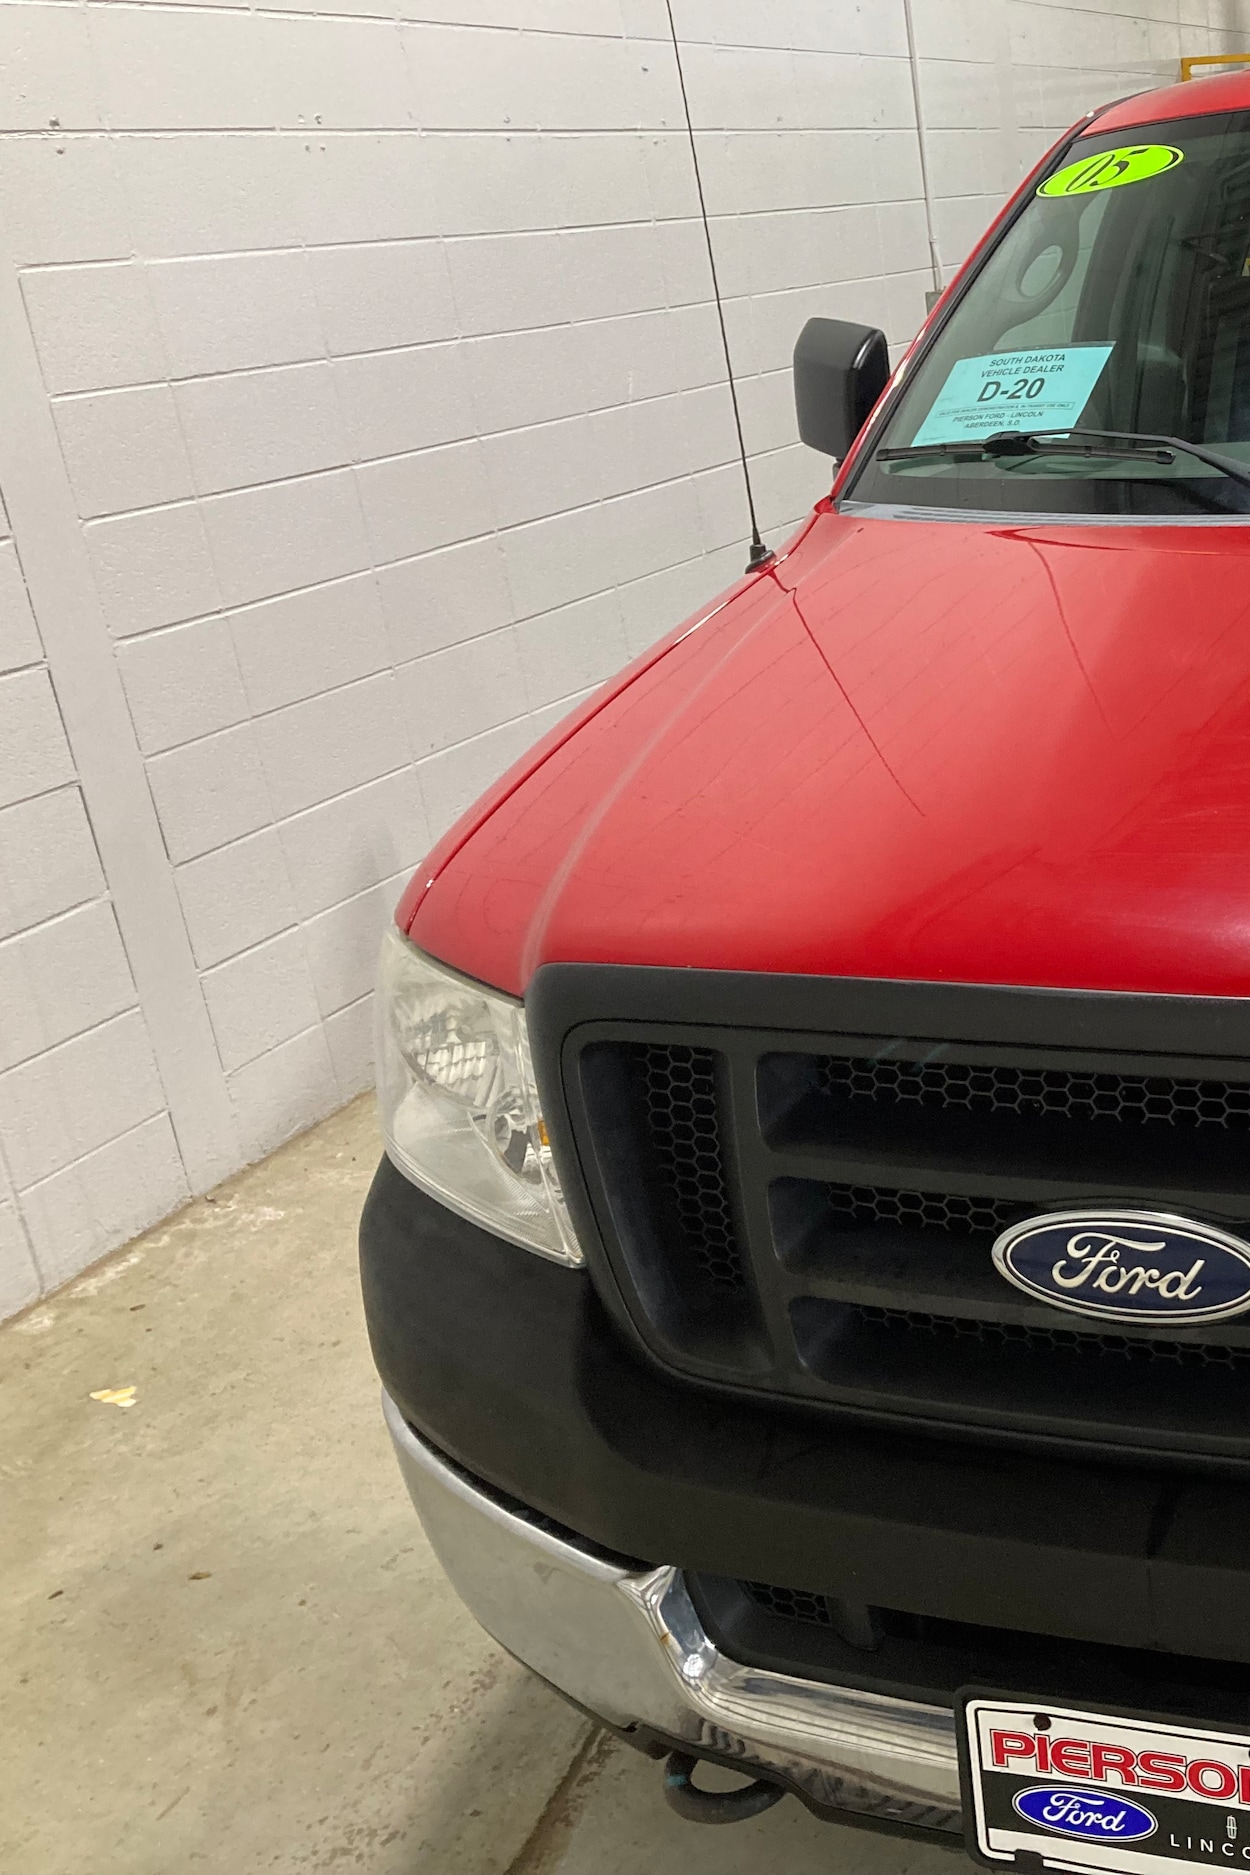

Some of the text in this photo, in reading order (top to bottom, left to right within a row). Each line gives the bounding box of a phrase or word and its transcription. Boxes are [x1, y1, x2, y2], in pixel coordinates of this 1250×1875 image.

[989, 354, 1066, 367] SOUTH DAKOTA
[981, 364, 1065, 378] VEHICLE DEALER
[977, 377, 1045, 402] D-20
[953, 413, 984, 423] PIERSON
[984, 412, 1006, 420] FORD
[964, 420, 1005, 429] ABERDEEN,
[1052, 1232, 1205, 1300] Ford
[1043, 1793, 1128, 1833] Ford
